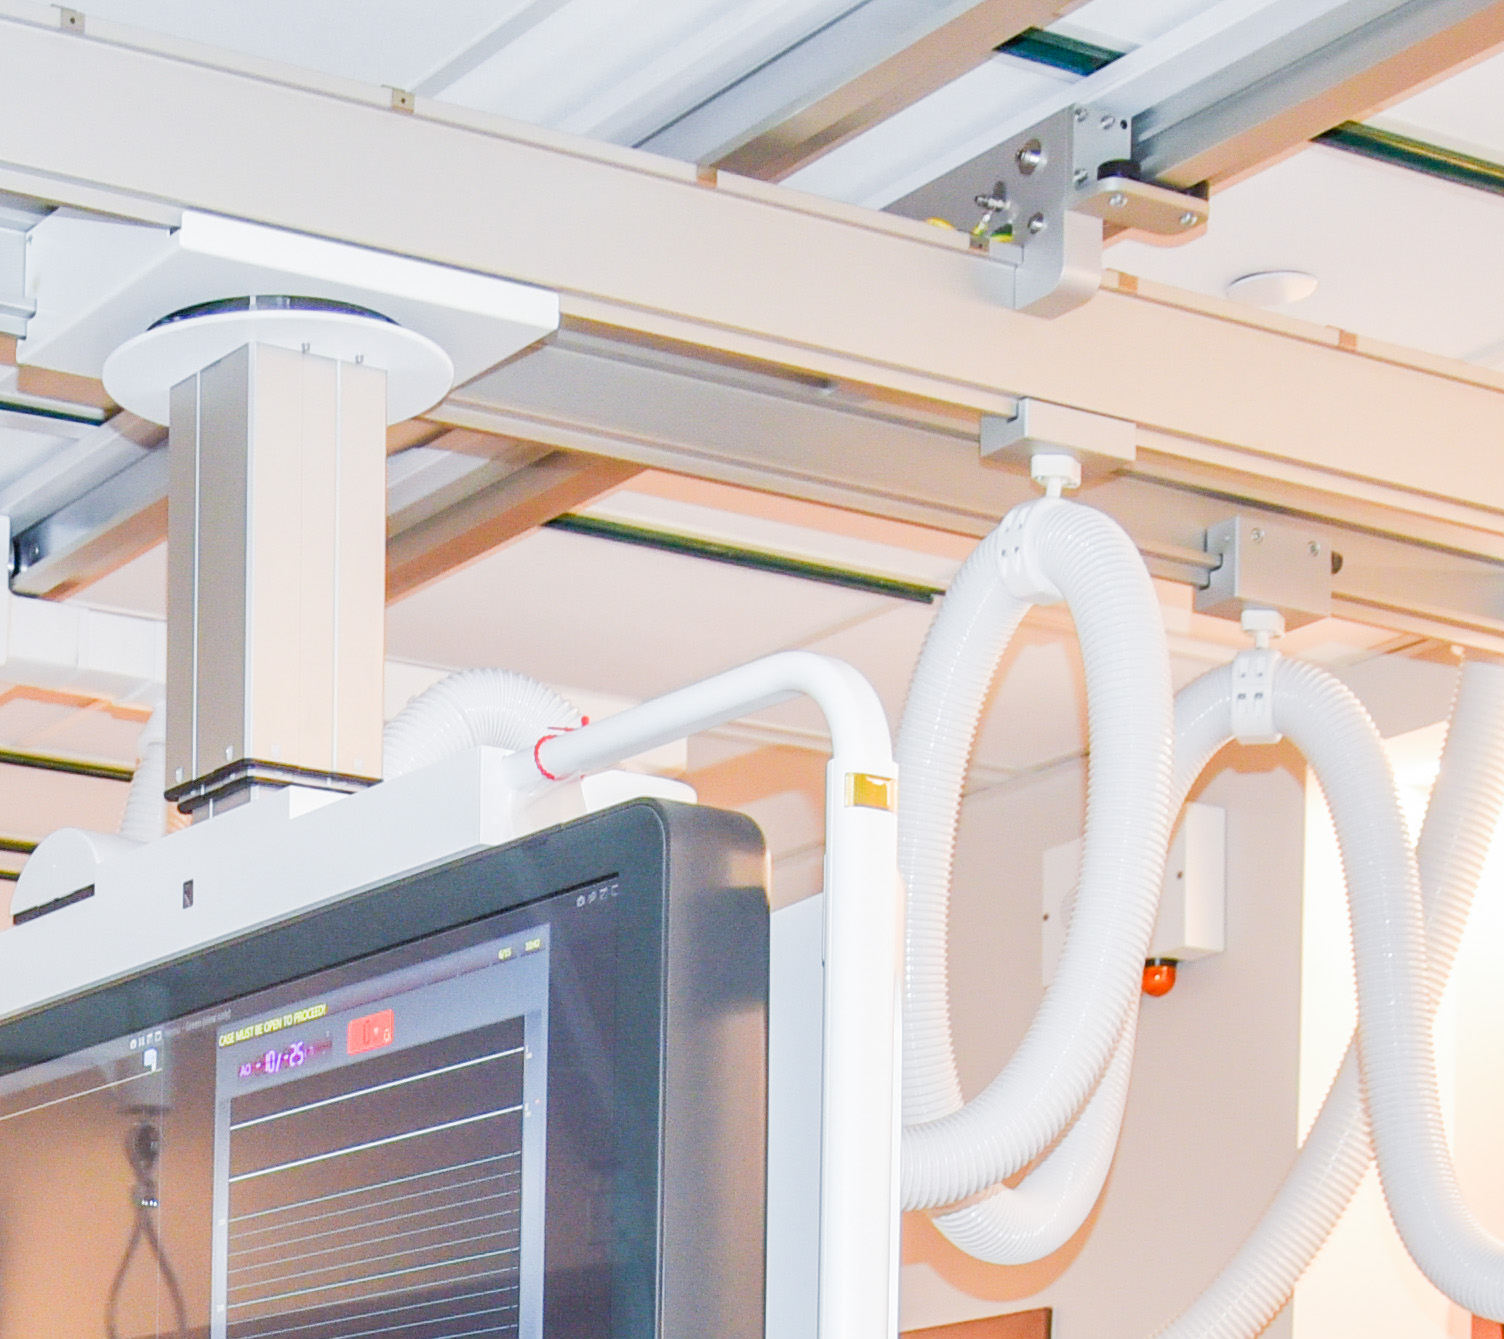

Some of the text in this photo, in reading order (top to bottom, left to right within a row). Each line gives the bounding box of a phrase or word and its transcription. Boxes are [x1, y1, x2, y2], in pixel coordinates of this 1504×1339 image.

[219, 1034, 235, 1047] CASE
[236, 1027, 254, 1041] MUST
[255, 1024, 264, 1036] BE
[264, 1019, 282, 1033] OPEN
[283, 1014, 292, 1027] TO
